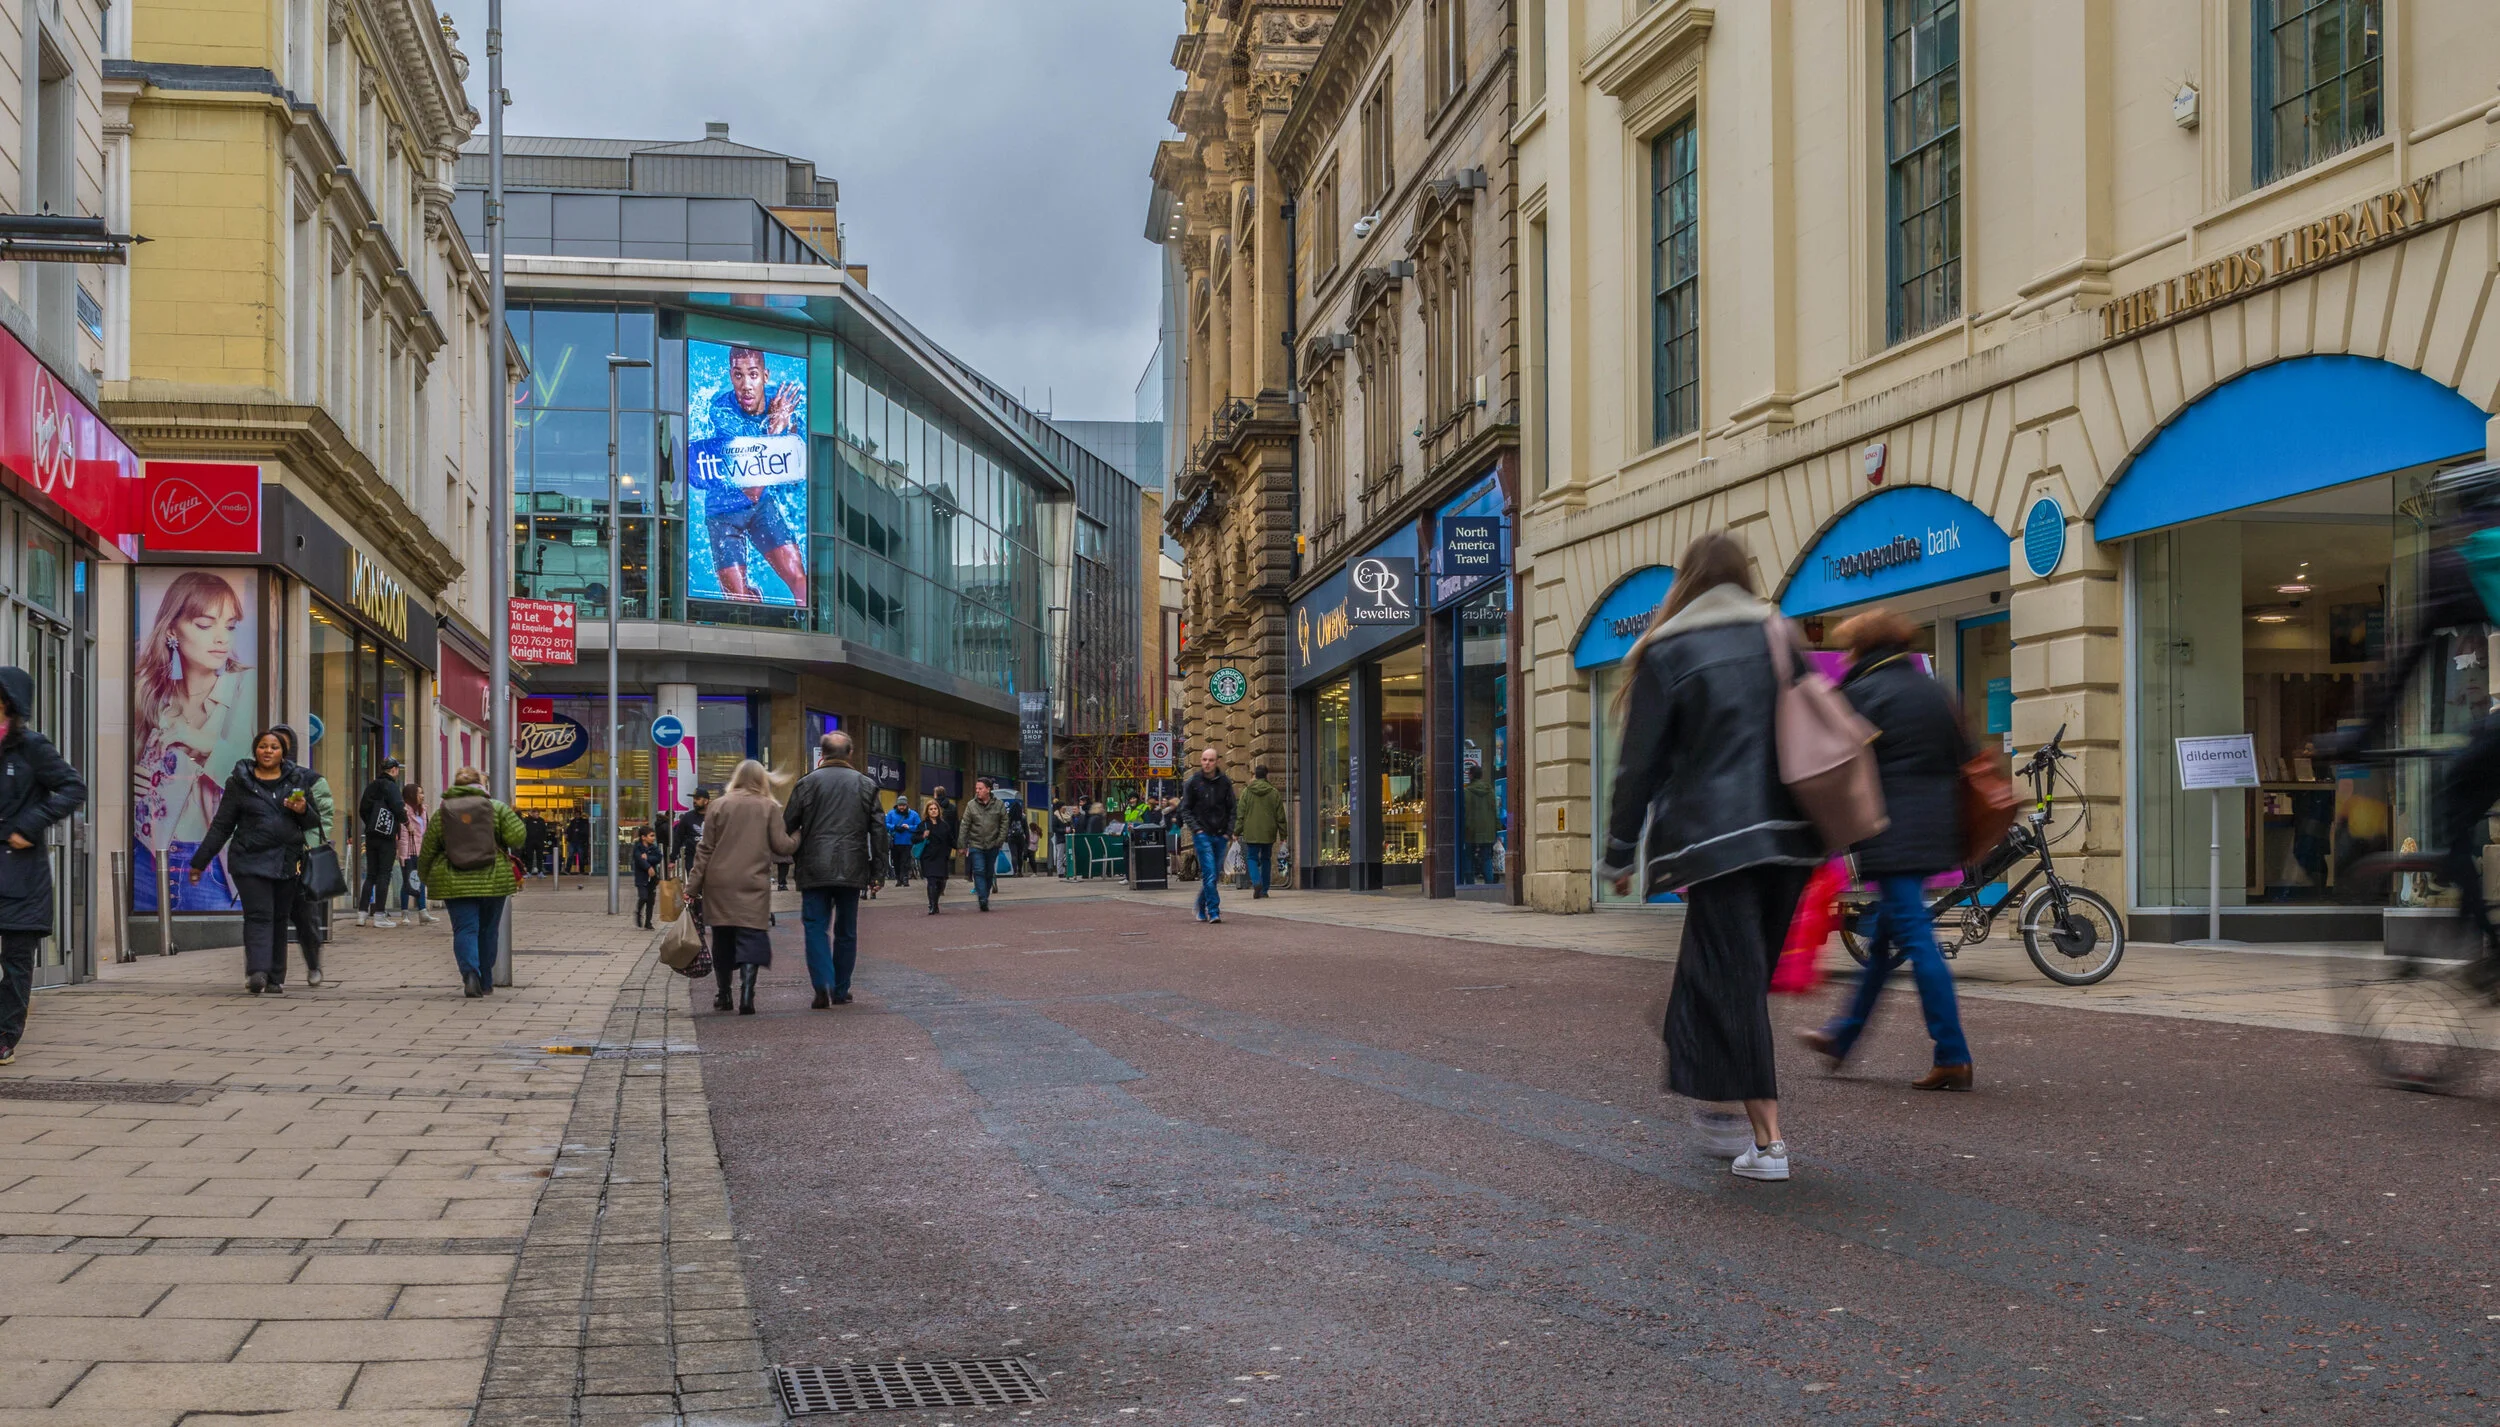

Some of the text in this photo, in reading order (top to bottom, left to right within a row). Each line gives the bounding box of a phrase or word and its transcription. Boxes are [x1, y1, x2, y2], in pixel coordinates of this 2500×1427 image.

[2099, 177, 2433, 341] THE LEEDS LIBRARY
[159, 488, 202, 525] Virgin
[221, 503, 248, 511] media
[1455, 526, 1488, 537] North
[1448, 540, 1495, 550] America
[1822, 555, 1842, 583] The
[1927, 520, 1961, 556] bank
[1454, 553, 1489, 564] Travel
[352, 545, 409, 643] MONSOON
[511, 600, 553, 611] Upper Floors
[511, 611, 540, 623] To Let
[1354, 606, 1411, 619] Jewellers
[511, 622, 553, 633] All Enquiries
[511, 634, 573, 649] 020 7629 8171
[511, 645, 573, 661] Knight Frank
[1212, 670, 1244, 685] STARBUCKS
[1216, 692, 1241, 702] COFFEE
[517, 722, 577, 758] Boots
[2186, 749, 2249, 762] dildermot
